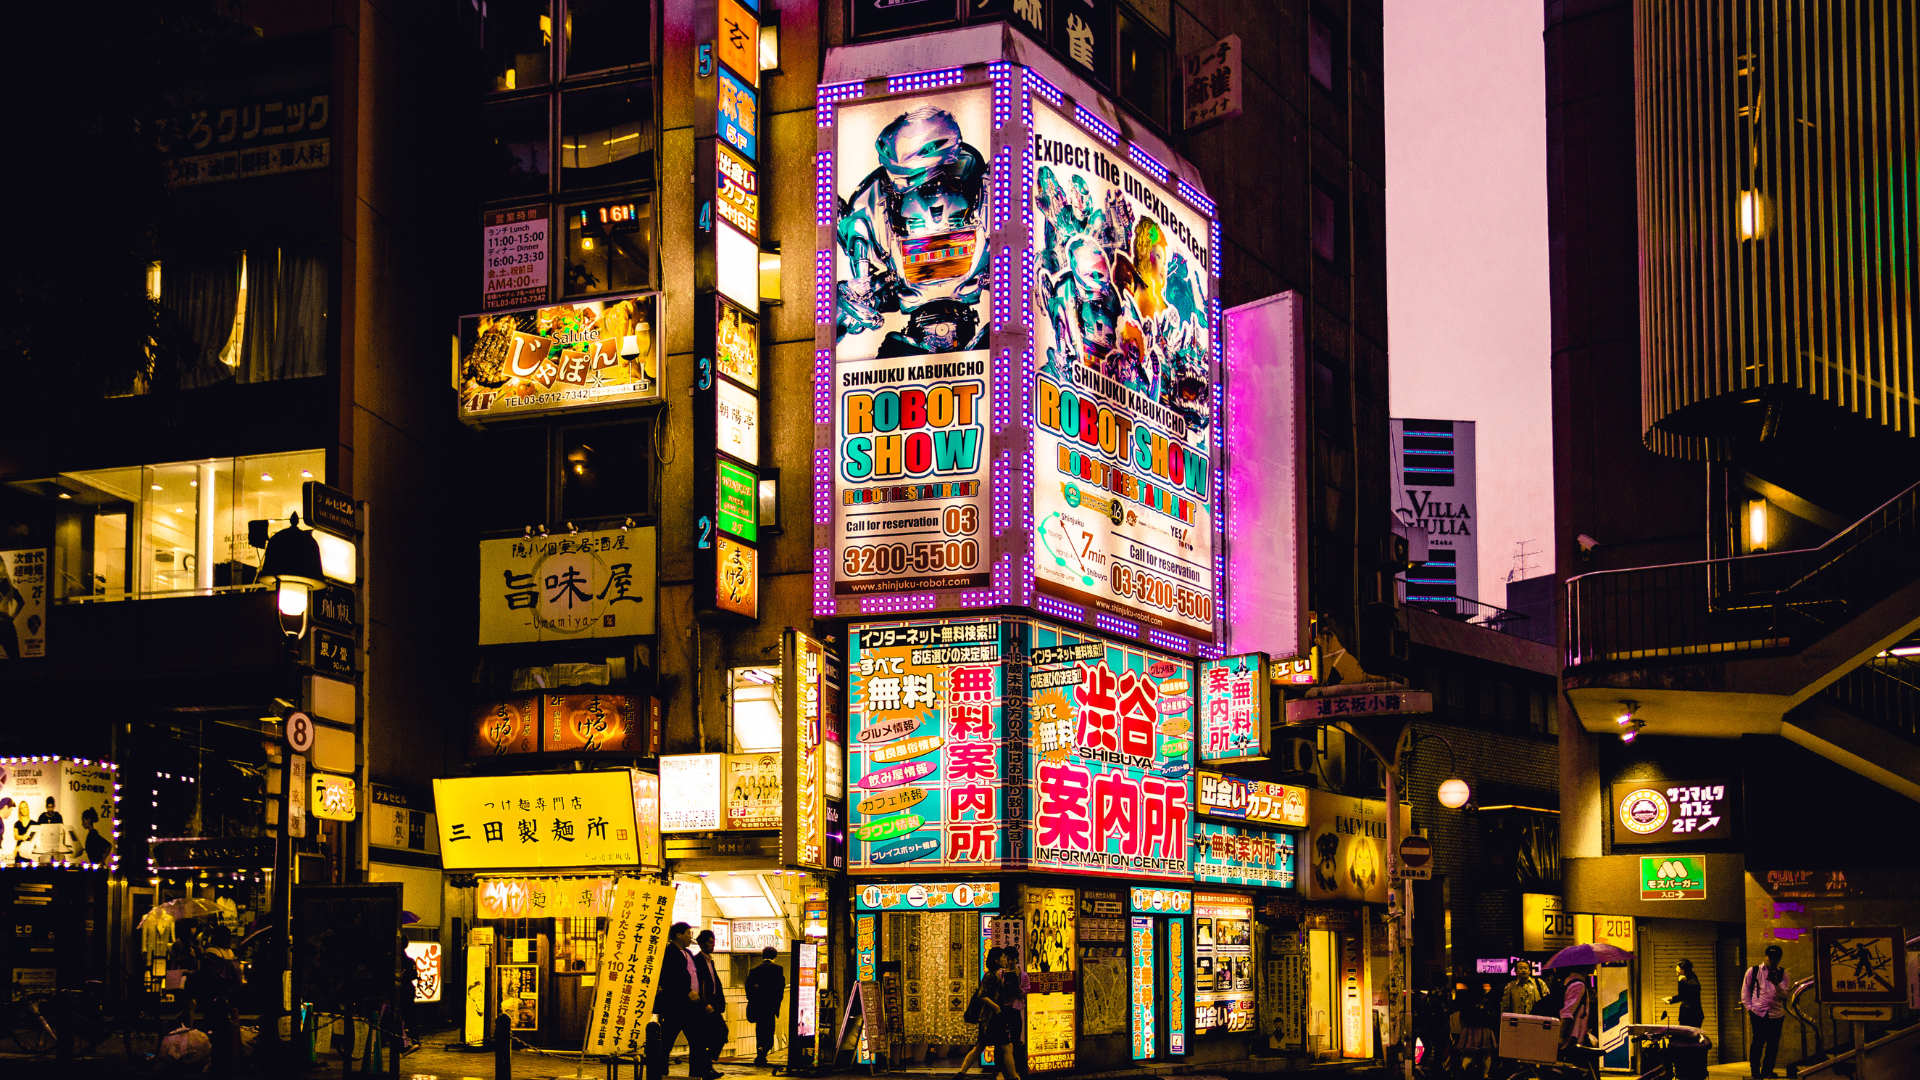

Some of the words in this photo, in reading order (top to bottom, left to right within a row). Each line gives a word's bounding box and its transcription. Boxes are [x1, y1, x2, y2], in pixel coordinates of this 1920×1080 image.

[700, 44, 712, 77] 5
[1187, 66, 1231, 109] 麻雀
[718, 75, 756, 136] 麻雀
[726, 123, 747, 149] 5F
[719, 153, 755, 192] 出会い
[723, 178, 755, 214] カフェ
[1034, 134, 1091, 172] Expect
[1094, 151, 1120, 187] the
[1124, 171, 1208, 272] unexpected
[496, 209, 536, 224] 営業時間
[699, 200, 711, 232] 4
[718, 198, 756, 234] 受付6F
[488, 227, 508, 236] ランチ
[510, 224, 530, 234] Lunch
[488, 231, 544, 248] 11:00-15:00
[488, 247, 515, 256] ディナー
[517, 243, 539, 252] Dinner
[488, 251, 544, 268] 16:00-23:30
[487, 264, 534, 279] 金、土、祝前日
[552, 330, 600, 346] Salute
[511, 336, 618, 386] じゃぽん
[699, 357, 711, 390] 3
[843, 369, 905, 387] SHINJUKU
[908, 361, 984, 381] KABUKICHO
[465, 391, 498, 412] 4F
[505, 389, 589, 408] TEL03-6712-7342
[847, 384, 978, 434] ROBOT
[1074, 363, 1127, 406] SHINJUKU
[1129, 394, 1185, 436] KABUKICHO
[719, 402, 754, 430] 朝陽亭
[1040, 380, 1132, 461] ROBOT
[1135, 425, 1208, 497] SHOW
[846, 428, 978, 478] SHOW
[844, 487, 890, 504] ROBOT
[891, 481, 979, 501] RESTAURANT
[1058, 443, 1110, 489] ROBOT
[1111, 465, 1196, 526] RESTAURANT
[317, 494, 354, 515] ナルセビル
[1406, 490, 1470, 519] VILLA
[731, 521, 743, 534] 2F
[846, 521, 865, 532] Call
[867, 520, 880, 531] for
[883, 517, 939, 530] reservation
[945, 507, 976, 534] 03
[1062, 513, 1084, 527] Shinjuku
[698, 516, 711, 549] 2
[719, 539, 727, 550] 2F
[14, 551, 44, 564] 次世代
[846, 541, 976, 574] 3200-5500
[1130, 545, 1145, 562] Call
[1147, 551, 1157, 565] for
[1159, 557, 1200, 582] reservation
[851, 577, 970, 592] www.shinjuku-robot.com
[1087, 568, 1108, 581] Shibuya
[32, 586, 43, 599] 2F
[503, 563, 643, 611] 旨味屋
[1112, 565, 1211, 622] 03-3200-5500
[1095, 599, 1163, 627] www.shinjuku-robot.com
[861, 625, 997, 647] インターネット無料検索!!
[911, 646, 998, 665] お店選びの決定版!!
[1031, 645, 1104, 664] インターネット無料検索!!
[859, 656, 905, 676] すべて
[1030, 669, 1083, 689] お店選びの決定版!!
[551, 695, 565, 706] 2F
[867, 673, 937, 711] 無料
[1032, 703, 1057, 721] すべて
[1075, 660, 1158, 758] 渋谷
[1209, 667, 1230, 752] 案内所
[1231, 681, 1251, 735] 無料
[1317, 694, 1400, 716] 道玄坂小路
[293, 718, 307, 746] 8
[578, 695, 609, 751] まるげん
[860, 719, 915, 741] グルメ情報
[1038, 719, 1077, 753] 無料
[805, 652, 818, 843] 出会いカフェ
[874, 735, 941, 760] 優良風俗情報
[1079, 747, 1153, 770] SHIBUYA
[1161, 741, 1188, 754] タウン情報
[868, 763, 929, 787] 飲み屋情報
[948, 666, 998, 863] 無料案内所
[16, 778, 38, 786] STATION
[1038, 694, 1188, 861] 案内所
[376, 791, 407, 804] ナルセビル
[861, 788, 923, 812] カフェ情報
[1200, 777, 1246, 808] 出会い
[1269, 785, 1281, 796] 6F
[1666, 785, 1725, 802] サンマルク
[101, 805, 112, 818] 2F
[484, 796, 583, 812] つけ麺専門店
[1246, 793, 1282, 819] カフェ
[1623, 792, 1650, 812] CHOCO
[1680, 800, 1712, 817] カフェ
[826, 807, 839, 822] Ride
[1336, 816, 1361, 835] BABY
[1672, 818, 1698, 833] 2F
[449, 816, 610, 844] 三田製麺所
[859, 815, 919, 839] タウン情報
[805, 845, 819, 863] 6F
[1036, 847, 1131, 867] INFORMATION
[1133, 855, 1185, 871] CENTER
[1211, 832, 1276, 866] 無料案内所
[834, 856, 843, 868] on
[880, 885, 902, 894] トイレ
[925, 884, 948, 893] タバコ
[973, 883, 992, 892] 充電
[1647, 880, 1700, 889] モスバーガー
[882, 893, 900, 908] OK
[927, 892, 947, 907] OK
[973, 891, 993, 907] OK
[608, 888, 636, 982] 見かけたらすぐ110番
[1545, 914, 1574, 935] 209
[1606, 920, 1631, 938] 209
[613, 891, 652, 1051] キャッチセールスは違法行為です。
[627, 895, 668, 1050] 路上での客引き行為、スカウト行為
[1141, 930, 1153, 1006] 全て無料
[1836, 980, 1877, 990] 横断禁止
[1196, 1006, 1228, 1028] 出会い
[1228, 1011, 1254, 1032] カフェ
